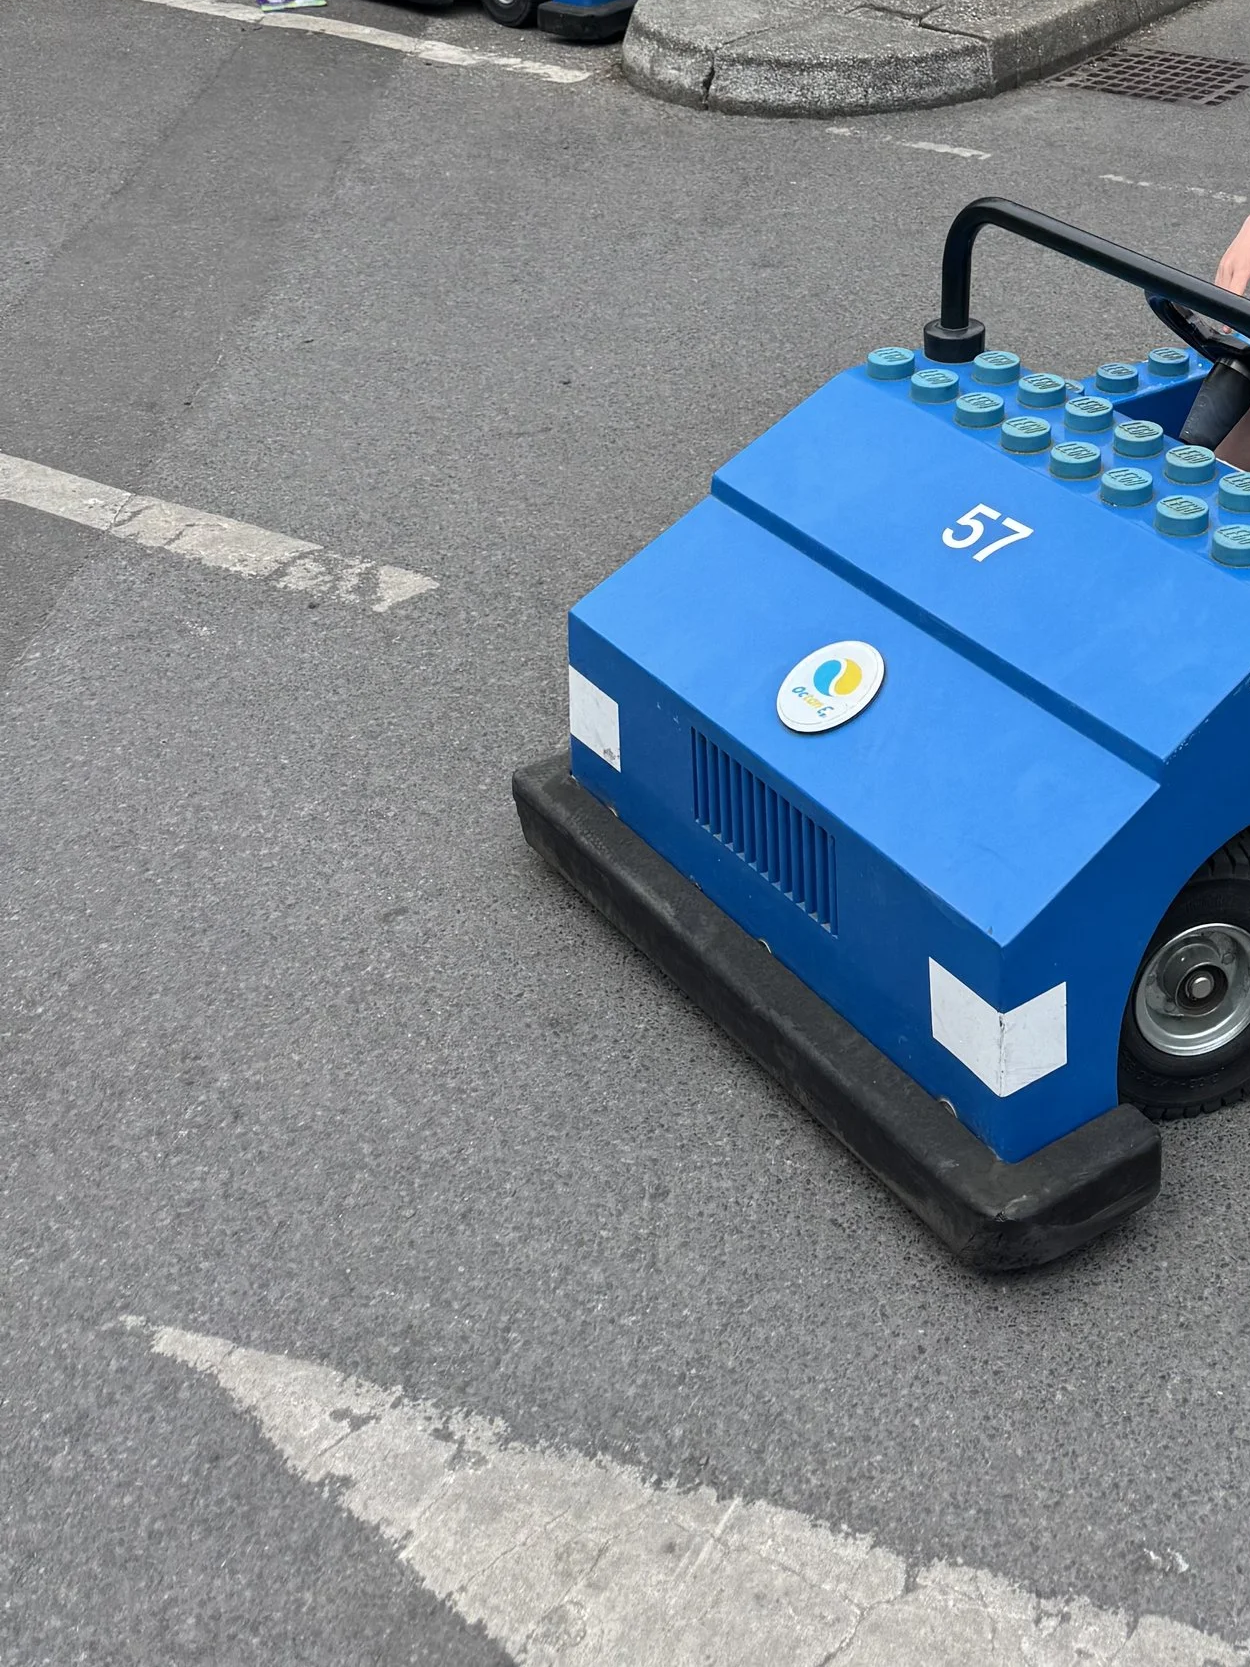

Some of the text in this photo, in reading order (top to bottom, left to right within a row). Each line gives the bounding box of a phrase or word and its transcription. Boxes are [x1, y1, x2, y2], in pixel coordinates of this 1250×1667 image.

[1171, 446, 1211, 464] LEGO
[1107, 469, 1148, 486] LEGO
[1160, 497, 1205, 515] LEGO
[942, 503, 1034, 562] 57
